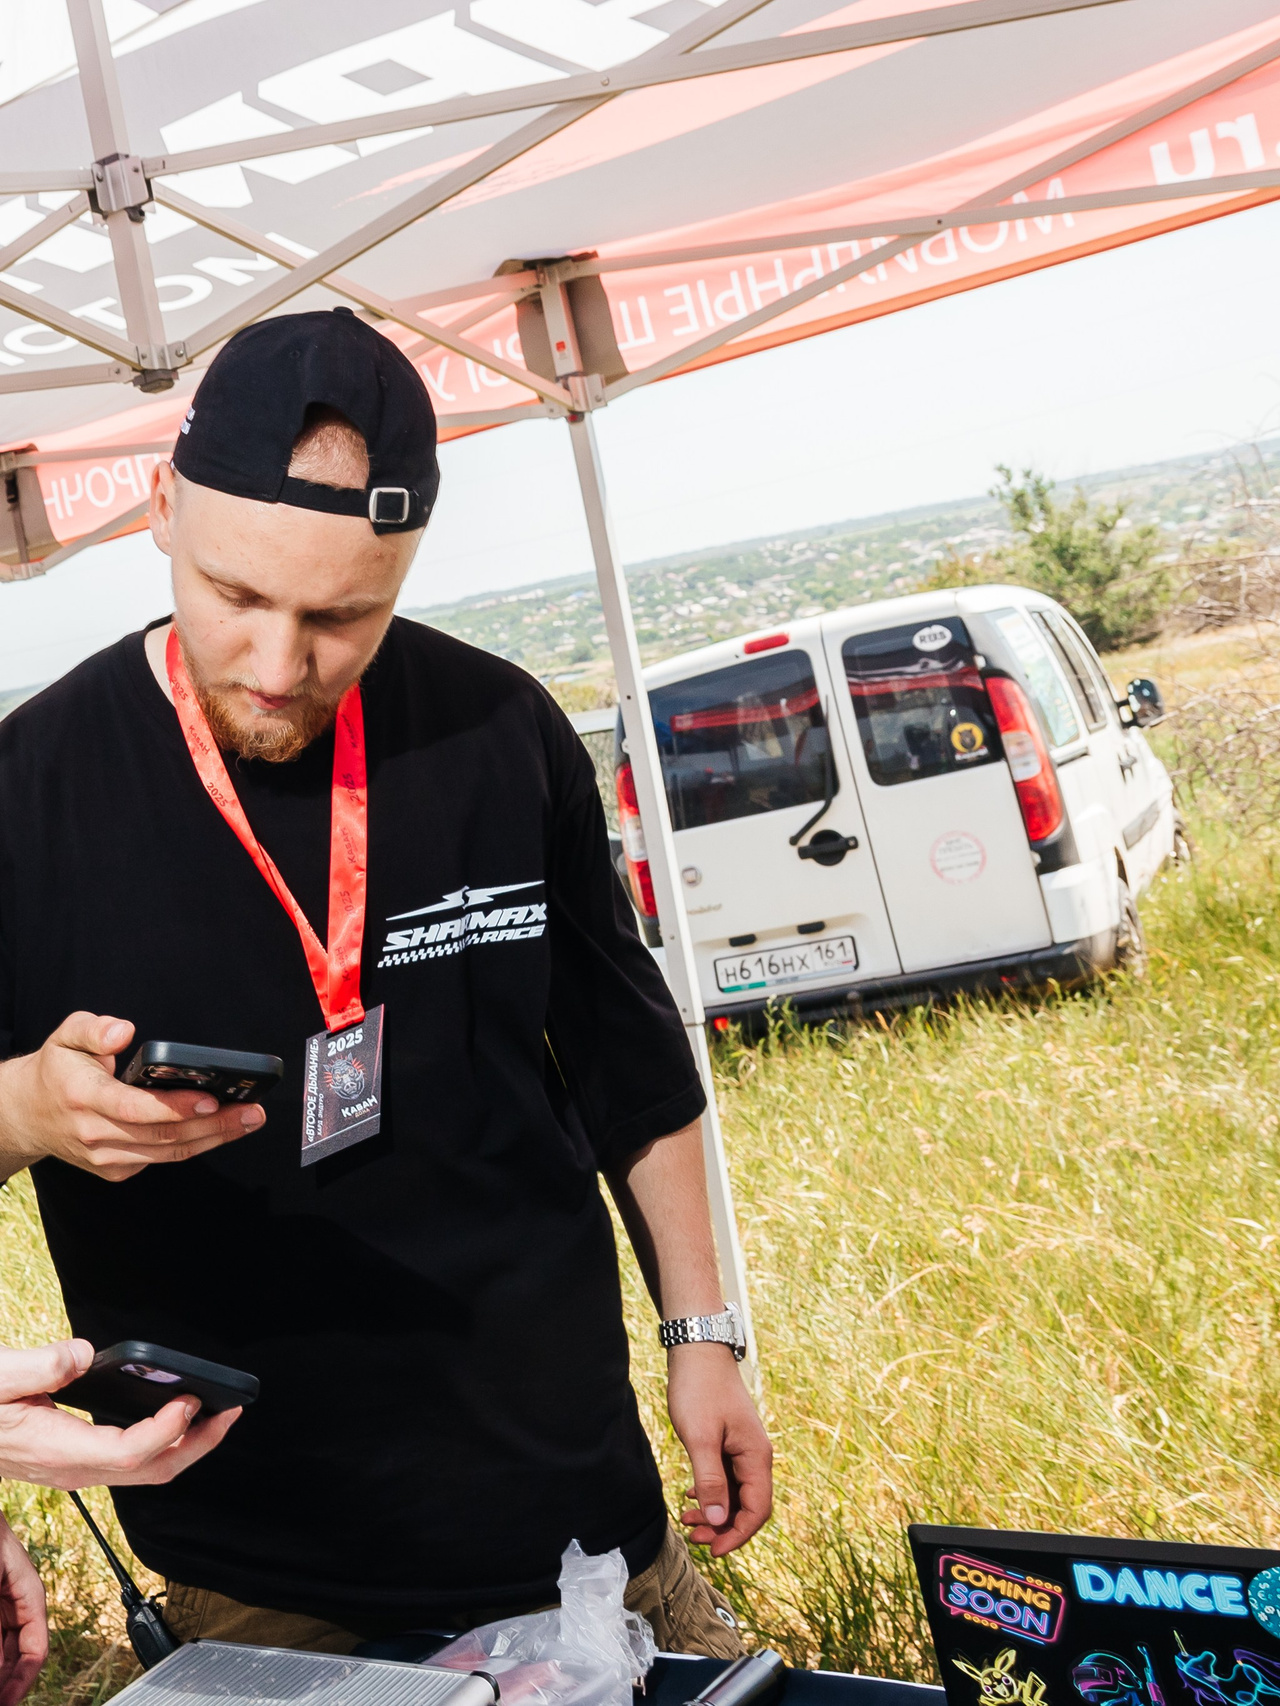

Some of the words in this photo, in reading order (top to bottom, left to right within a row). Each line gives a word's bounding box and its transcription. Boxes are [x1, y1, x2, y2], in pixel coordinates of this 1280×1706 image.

[206, 782, 228, 807] 2025
[382, 902, 548, 952] SHARMAX
[480, 924, 547, 944] RACE
[327, 1028, 364, 1057] 2025
[308, 1038, 319, 1096] ДЫХАНИЕ»
[948, 1582, 1050, 1636] SOON
[950, 1564, 1052, 1611] COMING
[1071, 1562, 1249, 1617] DANCE
